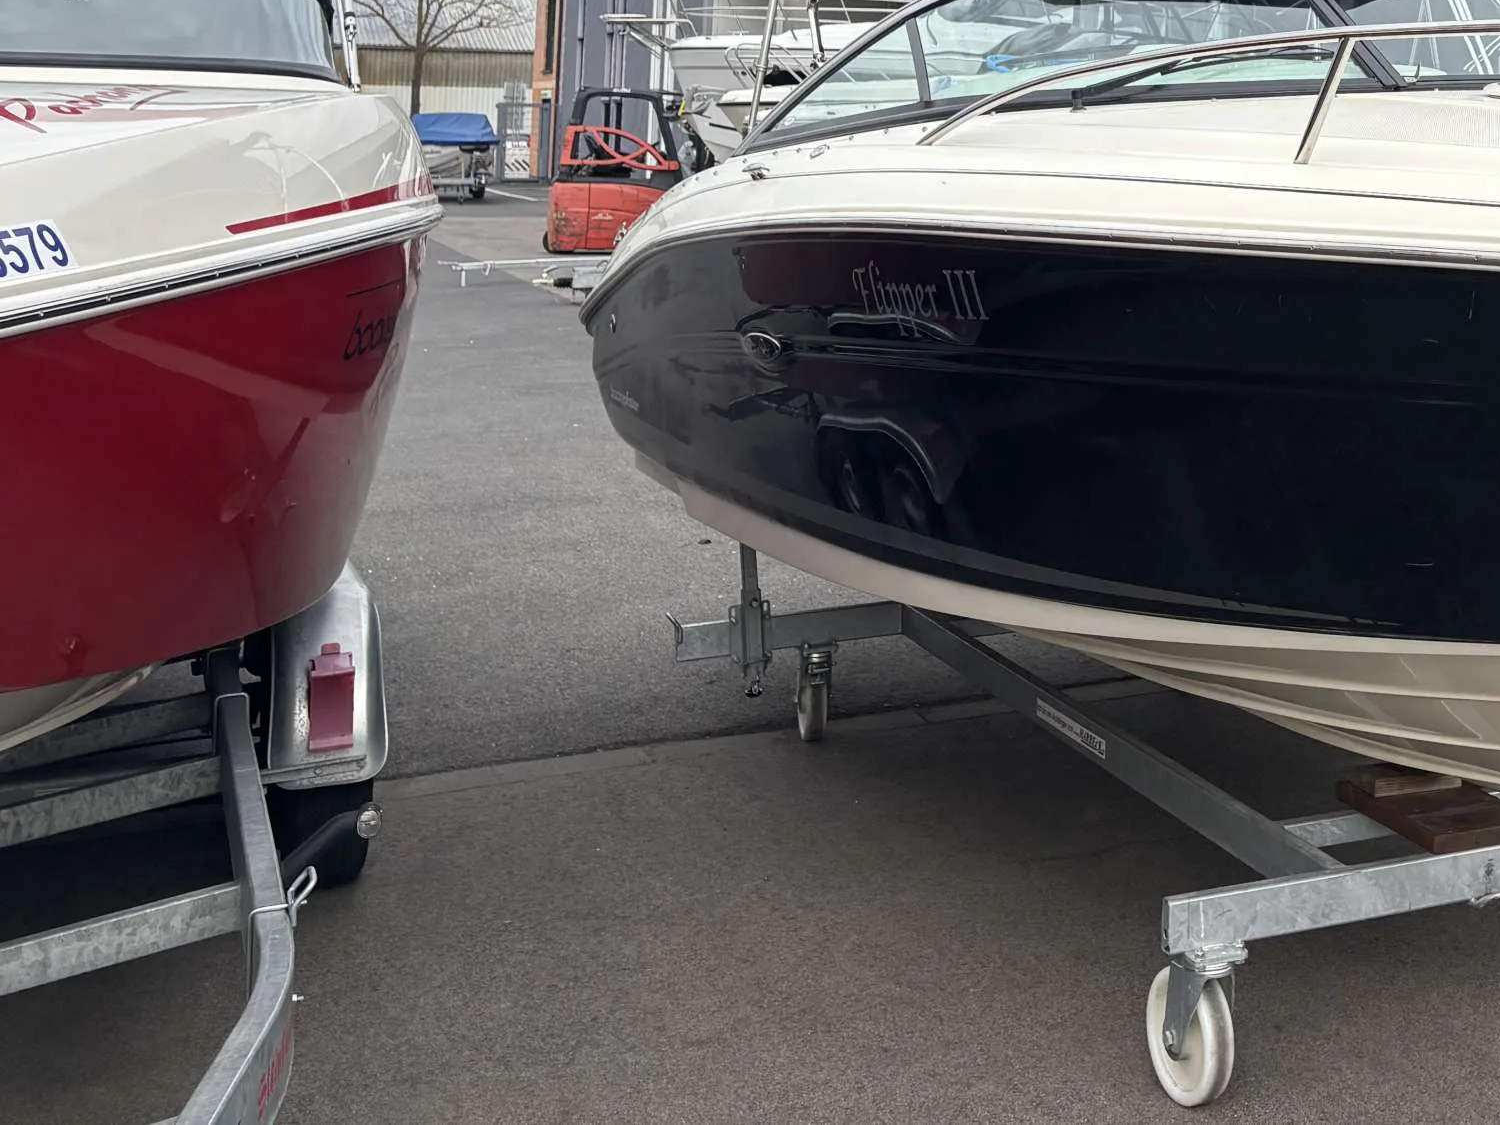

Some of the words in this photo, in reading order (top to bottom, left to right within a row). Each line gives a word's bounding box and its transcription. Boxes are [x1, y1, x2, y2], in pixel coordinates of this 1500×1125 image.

[0, 224, 69, 278] 579
[852, 260, 938, 338] Flipper
[942, 269, 990, 321] III
